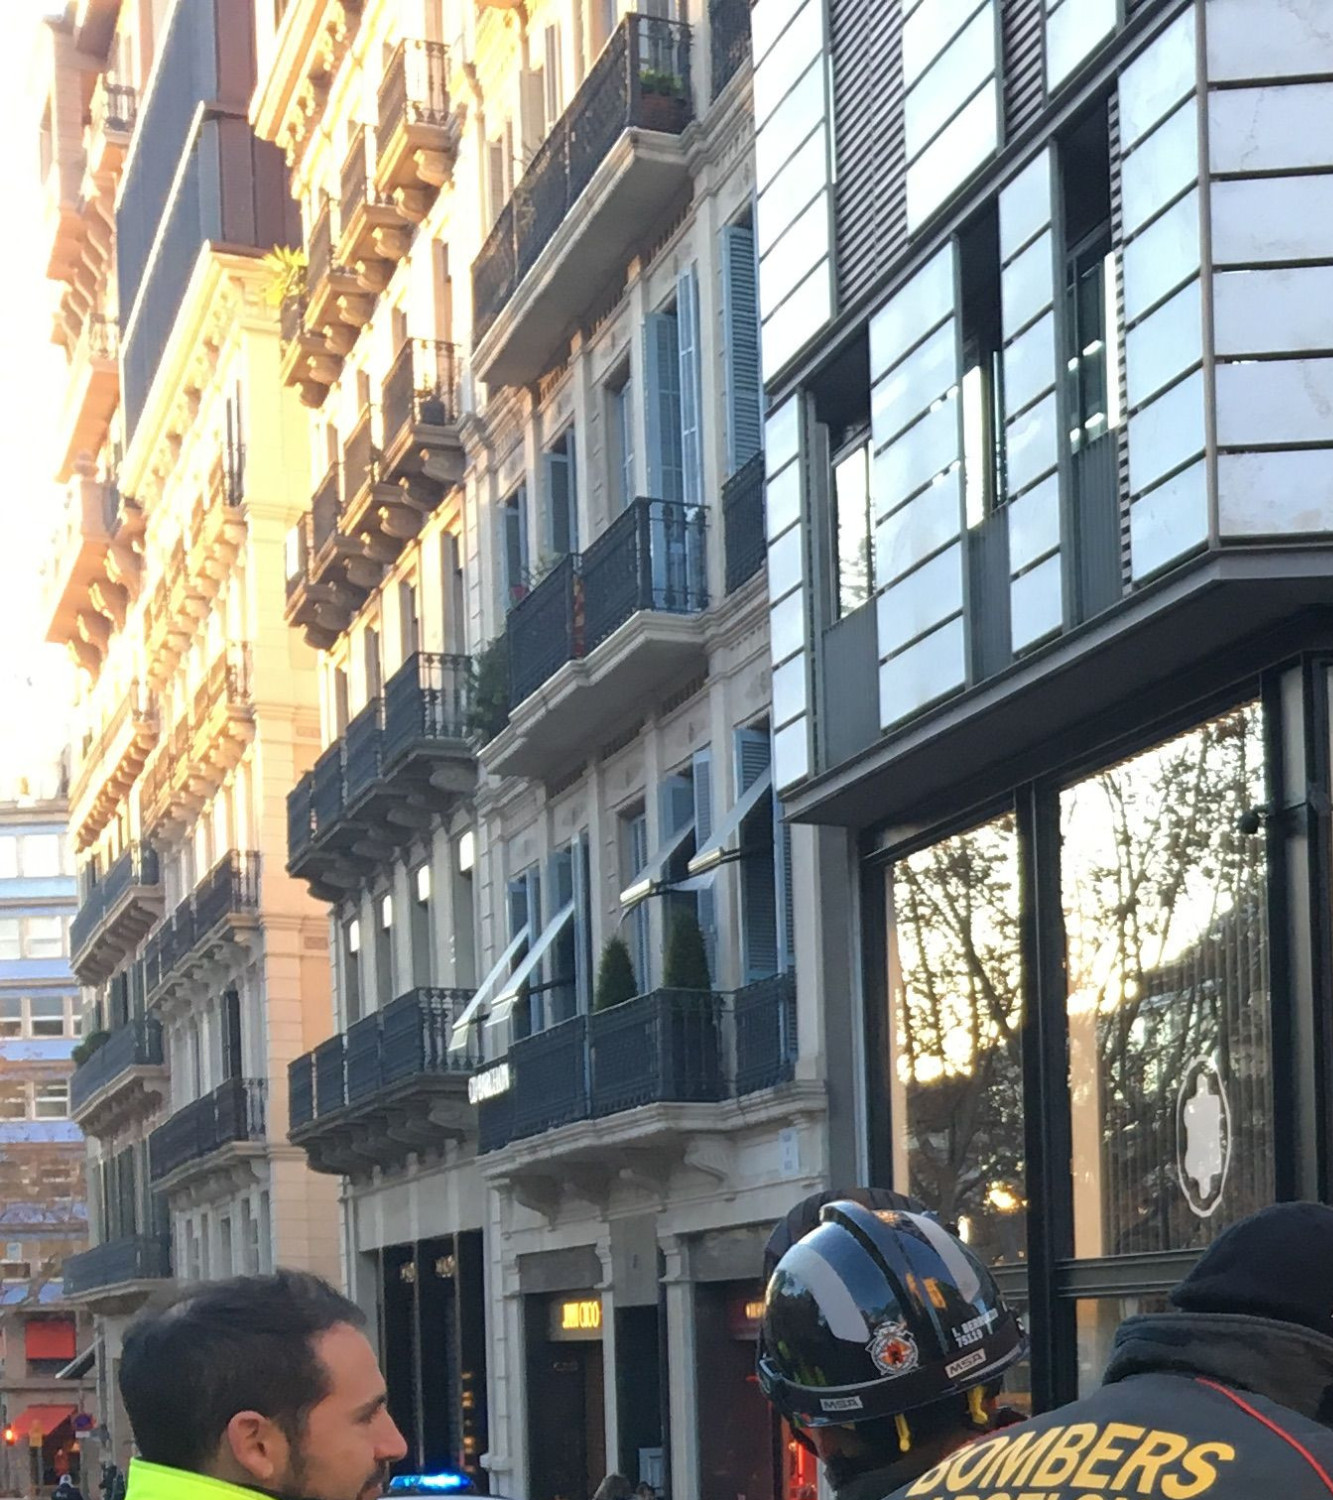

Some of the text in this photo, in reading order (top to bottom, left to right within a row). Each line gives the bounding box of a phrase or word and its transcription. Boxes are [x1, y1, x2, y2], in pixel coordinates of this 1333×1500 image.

[949, 1353, 984, 1376] MSA
[824, 1397, 861, 1409] MSA
[905, 1422, 1235, 1499] BOMBERS
